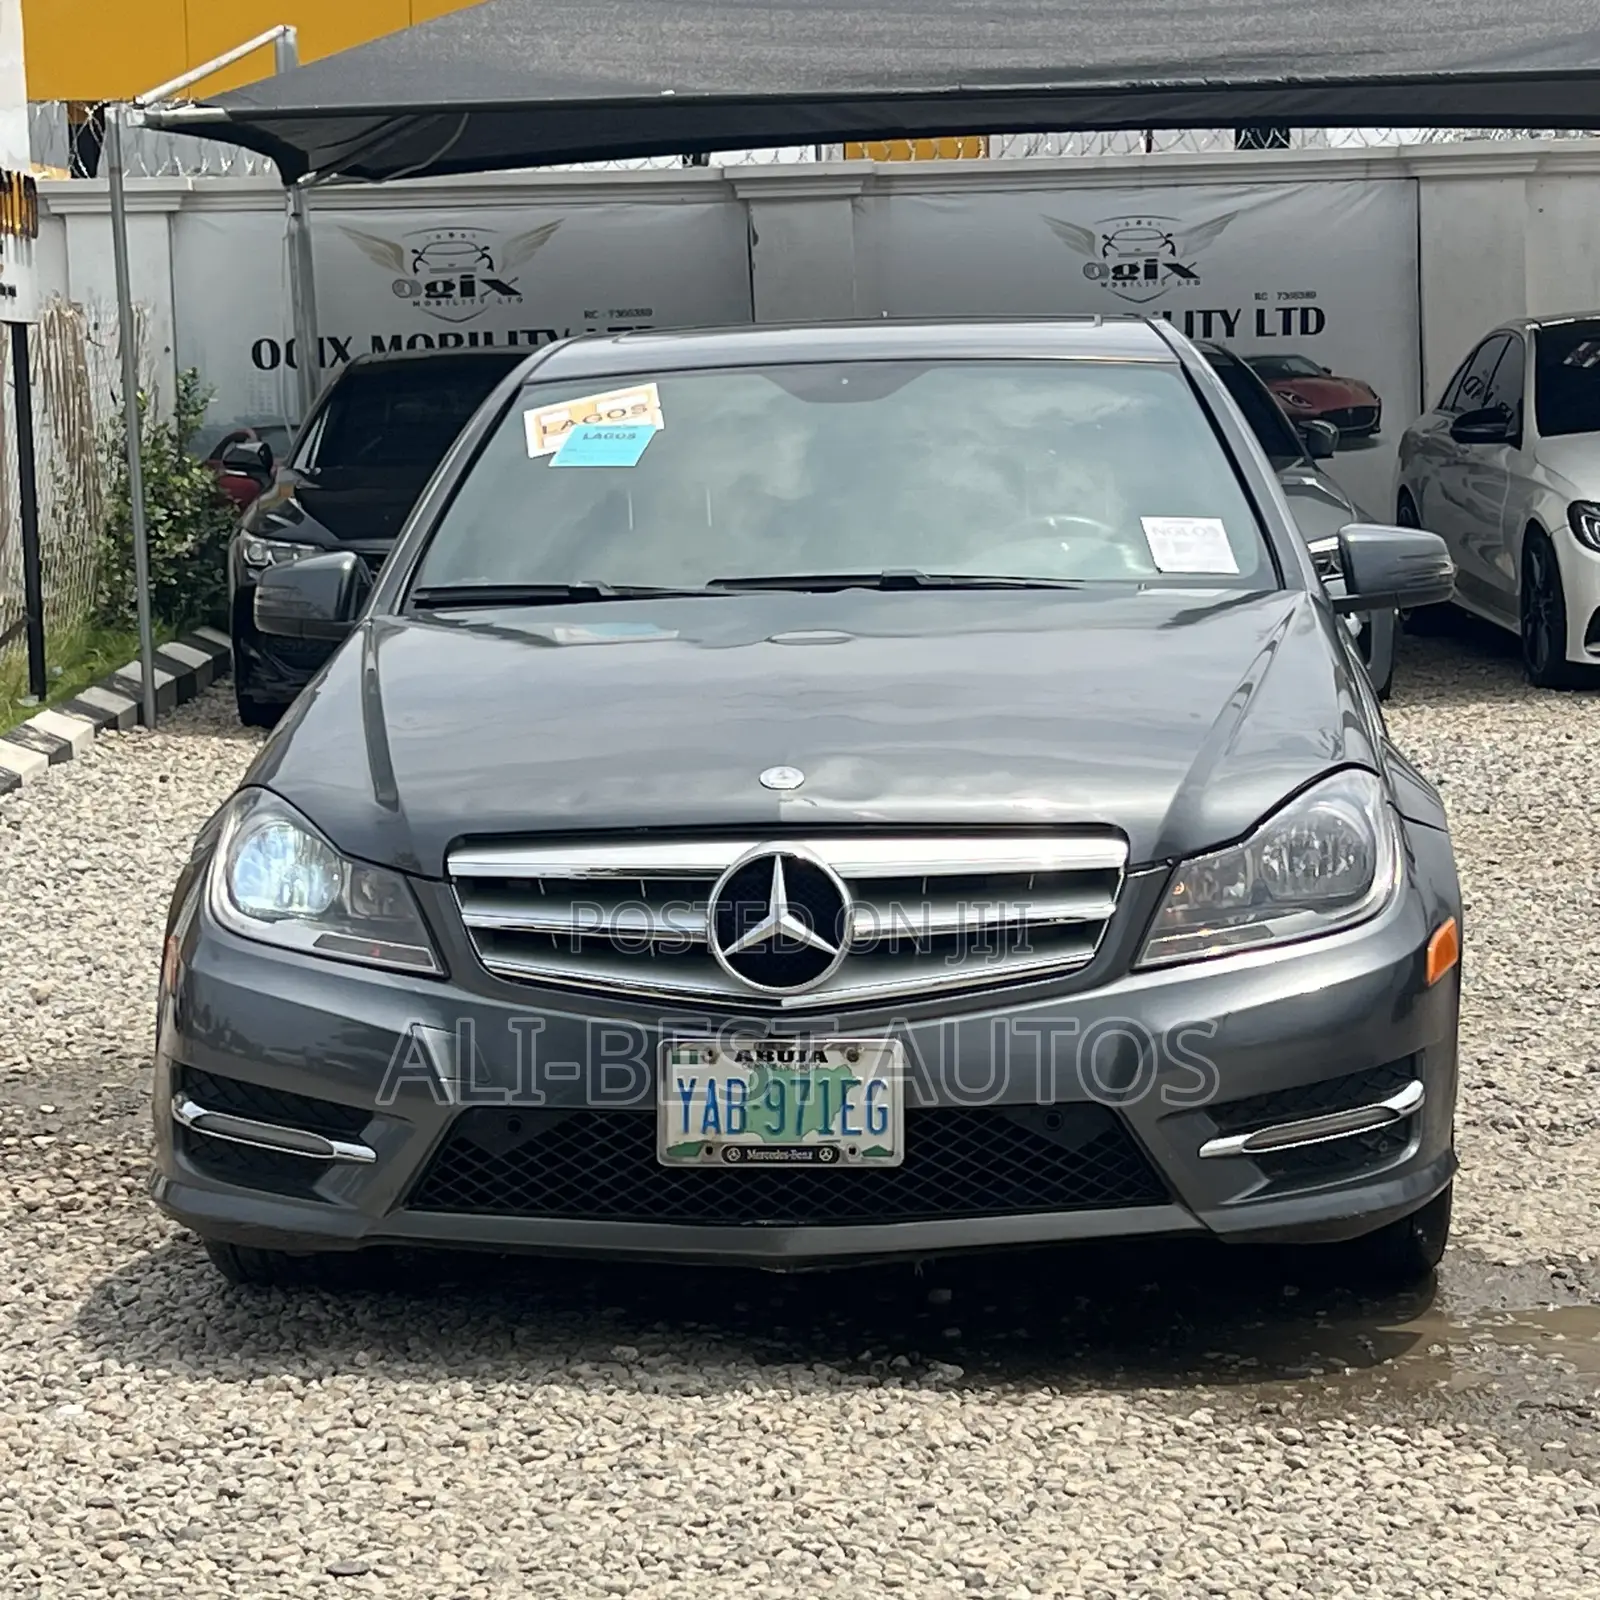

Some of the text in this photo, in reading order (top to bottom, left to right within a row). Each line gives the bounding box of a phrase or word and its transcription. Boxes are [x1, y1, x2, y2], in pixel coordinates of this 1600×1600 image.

[1256, 307, 1326, 337] LTD
[541, 403, 648, 435] LAGOS
[582, 432, 637, 441] LAGOS
[734, 1049, 829, 1063] ABUJA
[676, 1076, 889, 1136] YAB-971EG
[746, 1148, 814, 1161] Mercedes-Benz
